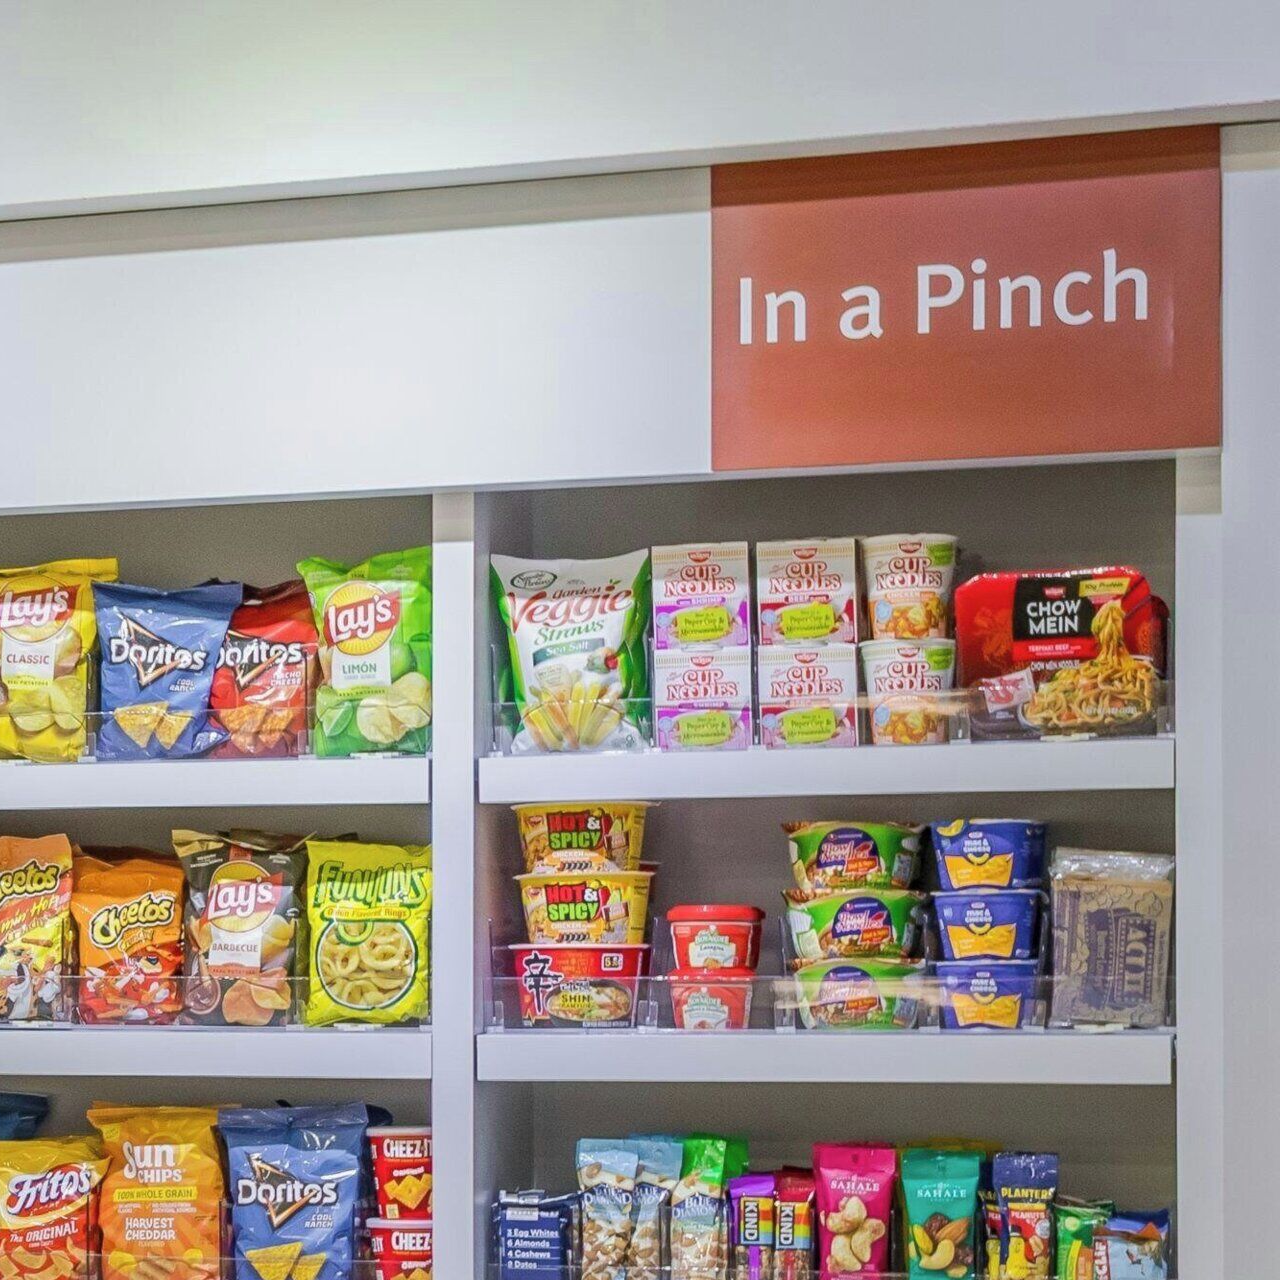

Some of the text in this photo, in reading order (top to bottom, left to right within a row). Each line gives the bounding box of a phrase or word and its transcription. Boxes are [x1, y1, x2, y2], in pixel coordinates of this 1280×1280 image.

[740, 248, 1148, 345] In a Pinch
[681, 565, 721, 581] CUP
[786, 562, 827, 578] CUP
[890, 557, 932, 573] CUP
[664, 577, 736, 597] NOODLES
[770, 574, 842, 594] NOODLES
[876, 571, 942, 590] NOODLES
[552, 586, 603, 600] Garden
[0, 588, 70, 628] Lay's
[508, 588, 633, 634] Veggie
[1026, 600, 1081, 617] CHOW
[329, 595, 395, 644] Lay's
[1029, 616, 1078, 636] MEIN
[534, 619, 605, 647] Straws
[6, 654, 50, 665] CLASSIC
[110, 638, 208, 672] Doritos
[342, 661, 377, 675] LIMÓN
[683, 670, 723, 685] CUP
[787, 666, 827, 682] CUP
[888, 662, 930, 677] CUP
[667, 682, 738, 701] NOODLES
[771, 679, 843, 698] NOODLES
[876, 675, 942, 693] NOODLES
[547, 811, 600, 832] HOT &
[549, 831, 601, 851] SPICY
[208, 876, 274, 920] Lay's
[544, 882, 598, 904] HOT &
[90, 895, 176, 948] Cheetos
[547, 902, 598, 922] SPICY
[1125, 928, 1147, 969] ACT
[123, 1141, 176, 1180] Sun
[137, 1168, 182, 1183] CHIPS
[7, 1165, 90, 1214] Fritos
[165, 1188, 193, 1198] GRAIN
[237, 1180, 338, 1204] Doritos
[830, 1181, 880, 1191] SAHALE
[917, 1189, 967, 1198] SAHALE
[1001, 1188, 1054, 1199] PLANTERS
[125, 1217, 175, 1230] HARVEST
[744, 1201, 758, 1241] KIND
[780, 1204, 793, 1245] KIND
[25, 1220, 79, 1242] ORIGINAL
[125, 1229, 176, 1241] CHEDDAR
[514, 1229, 531, 1239] Egg
[532, 1229, 558, 1237] Whites
[507, 1250, 550, 1259] 4 Cashews
[514, 1261, 538, 1269] Dates
